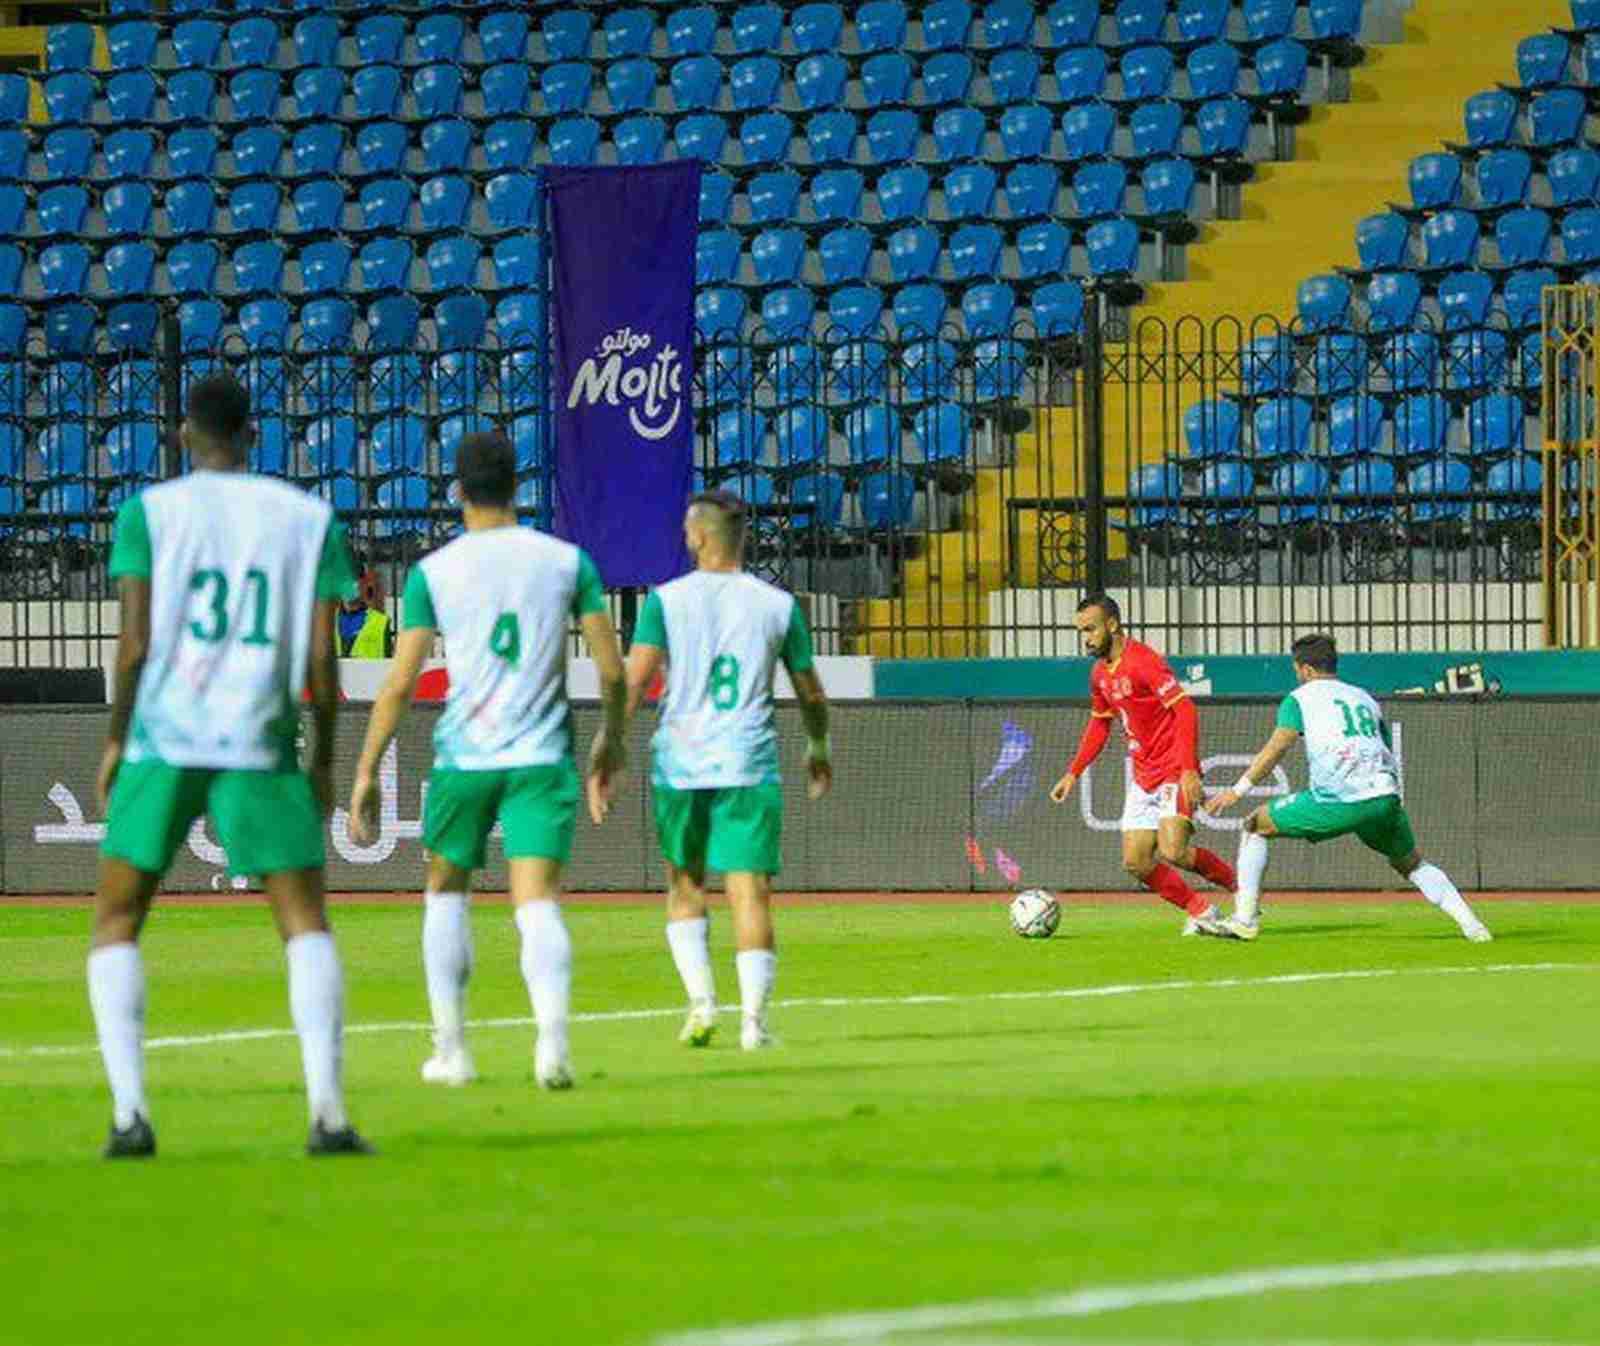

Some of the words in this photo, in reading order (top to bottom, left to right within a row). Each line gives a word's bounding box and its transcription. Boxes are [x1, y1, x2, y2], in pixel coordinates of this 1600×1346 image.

[598, 327, 651, 358] مولتو
[189, 565, 273, 646] 31
[489, 611, 521, 667] 4
[709, 652, 740, 712] 8
[1333, 698, 1377, 738] 18
